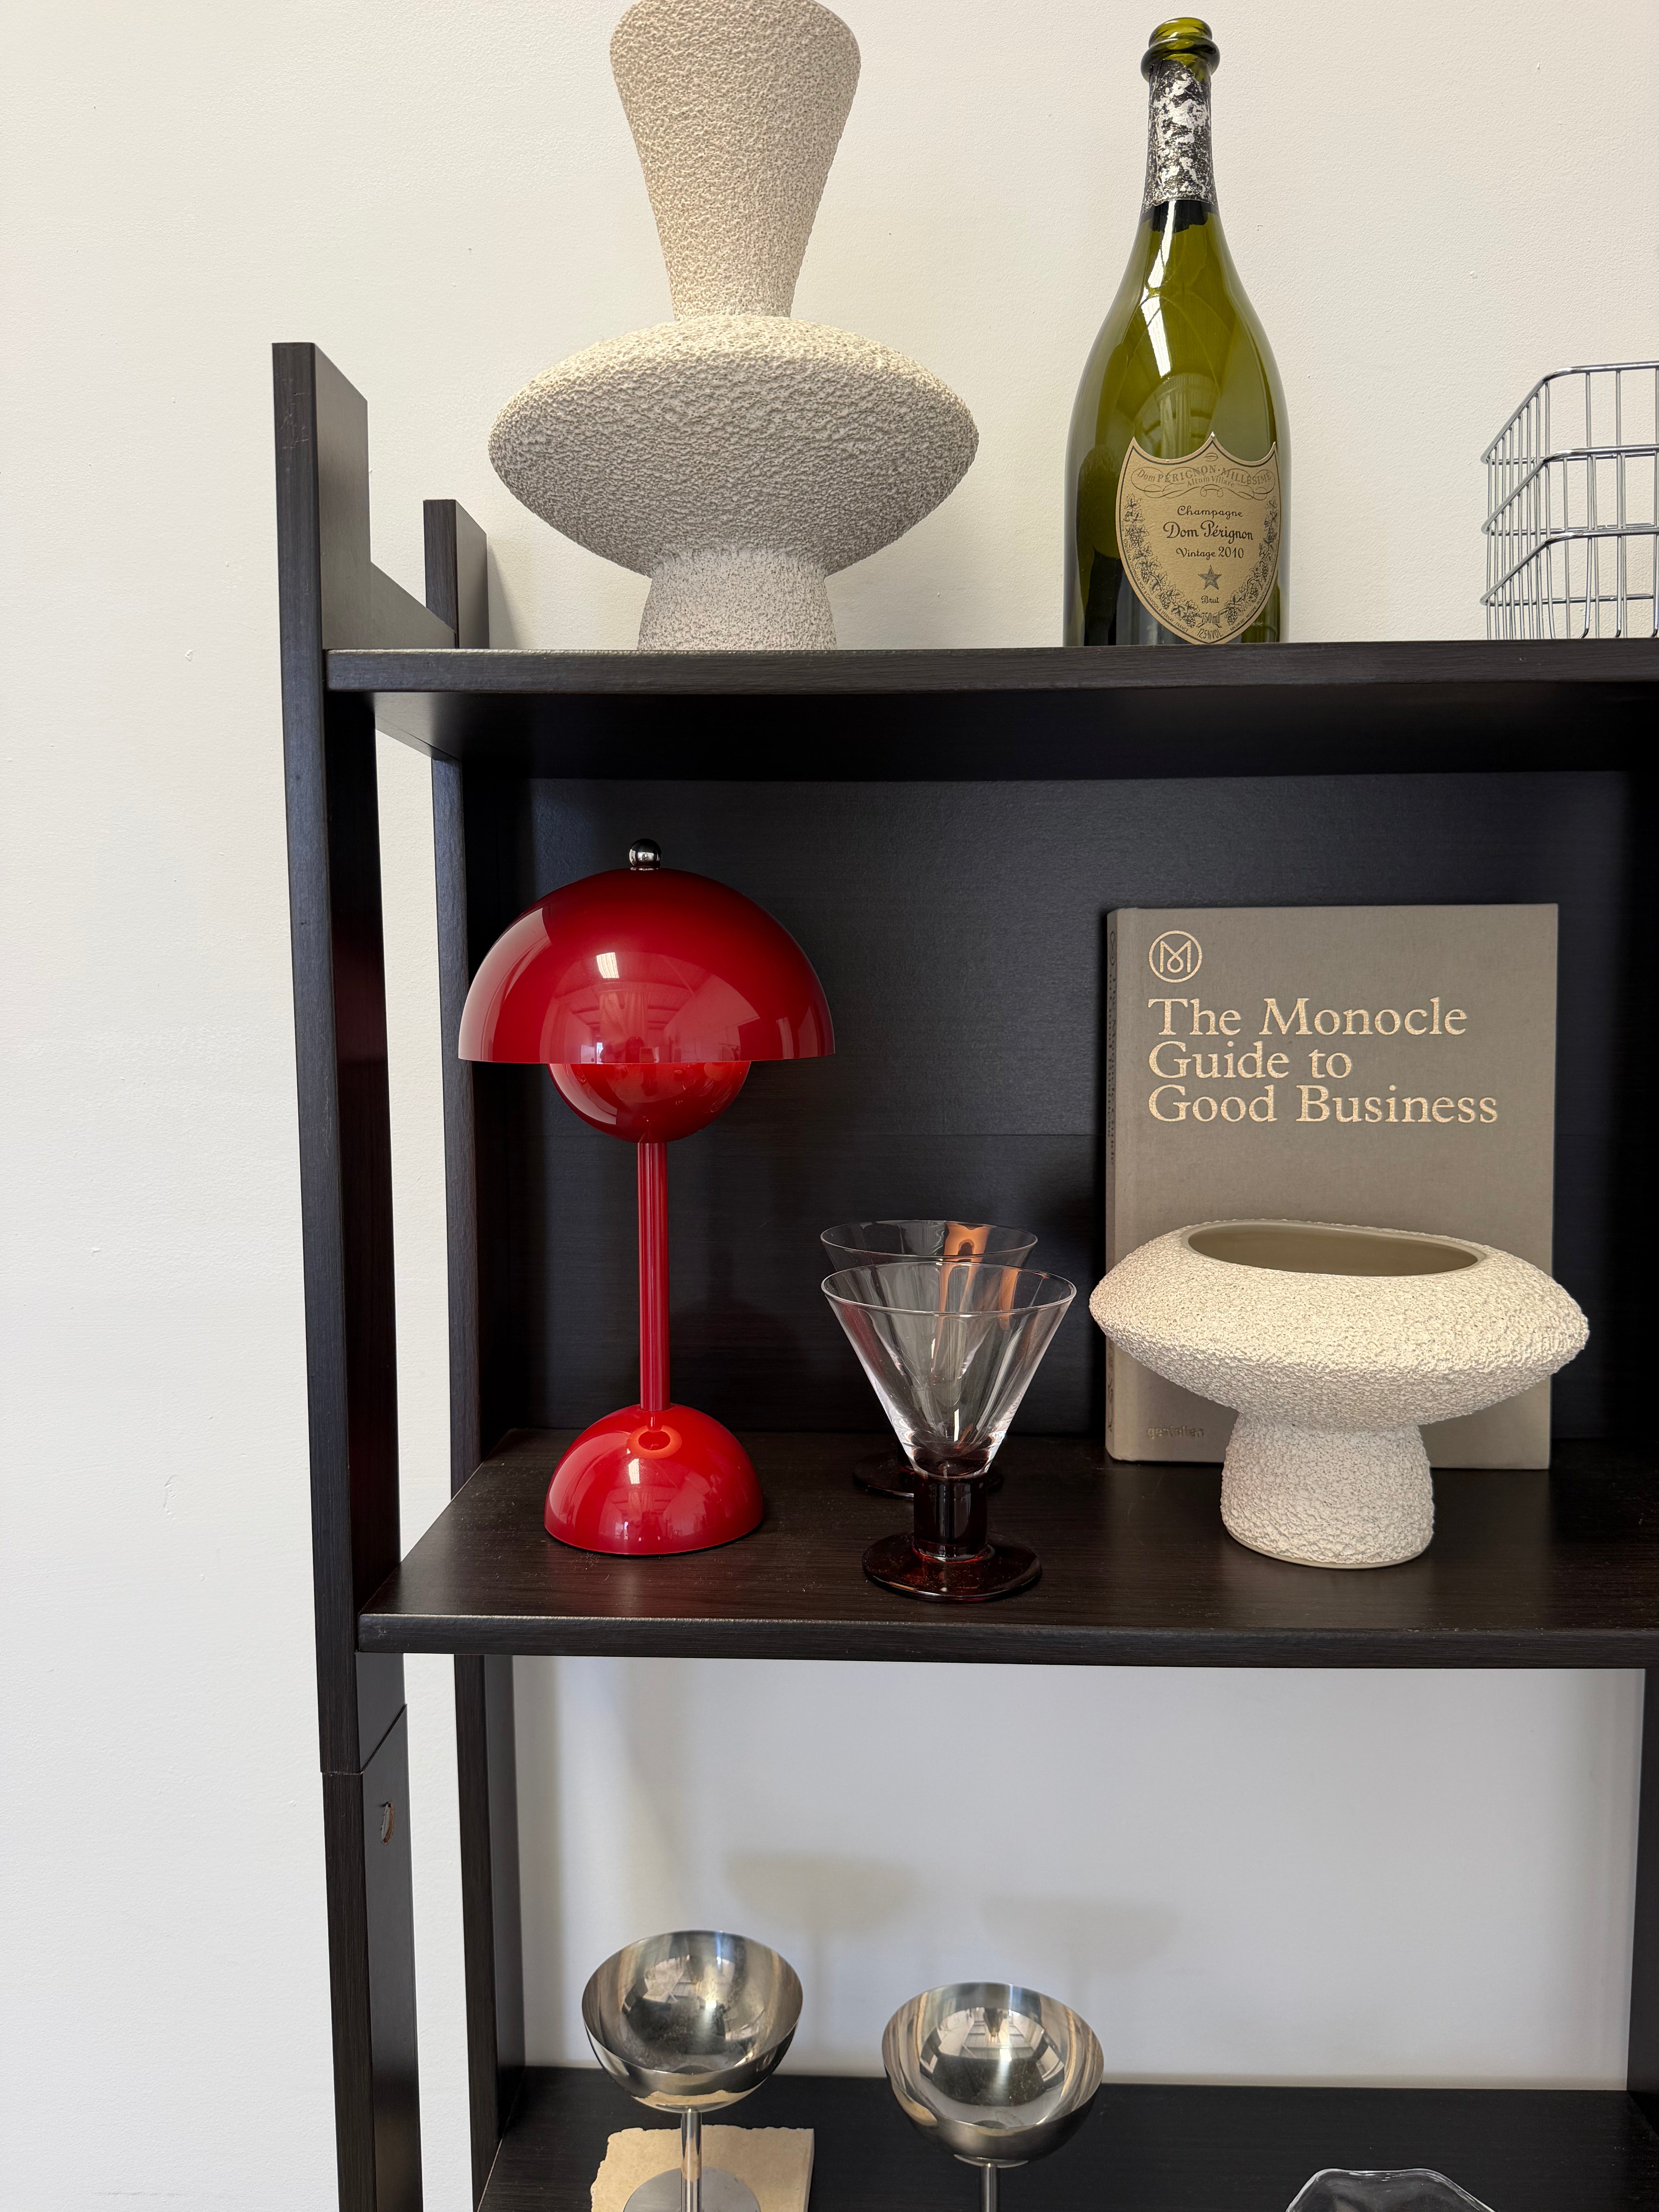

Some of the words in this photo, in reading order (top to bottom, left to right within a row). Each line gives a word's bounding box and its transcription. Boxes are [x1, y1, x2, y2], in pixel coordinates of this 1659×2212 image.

[1137, 469, 1155, 482] Dom
[1187, 476, 1210, 487] Altum
[1177, 505, 1243, 520] Champagne
[1163, 522, 1199, 539] Dom
[1200, 520, 1254, 544] Pérignon
[1176, 548, 1216, 560] Vintage
[1218, 547, 1244, 559] 2010
[1201, 595, 1219, 604] Brut
[1202, 612, 1220, 623] 750ml
[1148, 998, 1241, 1036] The
[1259, 996, 1467, 1036] Monocle
[1148, 1041, 1289, 1079] Guide
[1308, 1049, 1352, 1078] to
[1148, 1084, 1277, 1122] Good
[1296, 1085, 1497, 1123] Business
